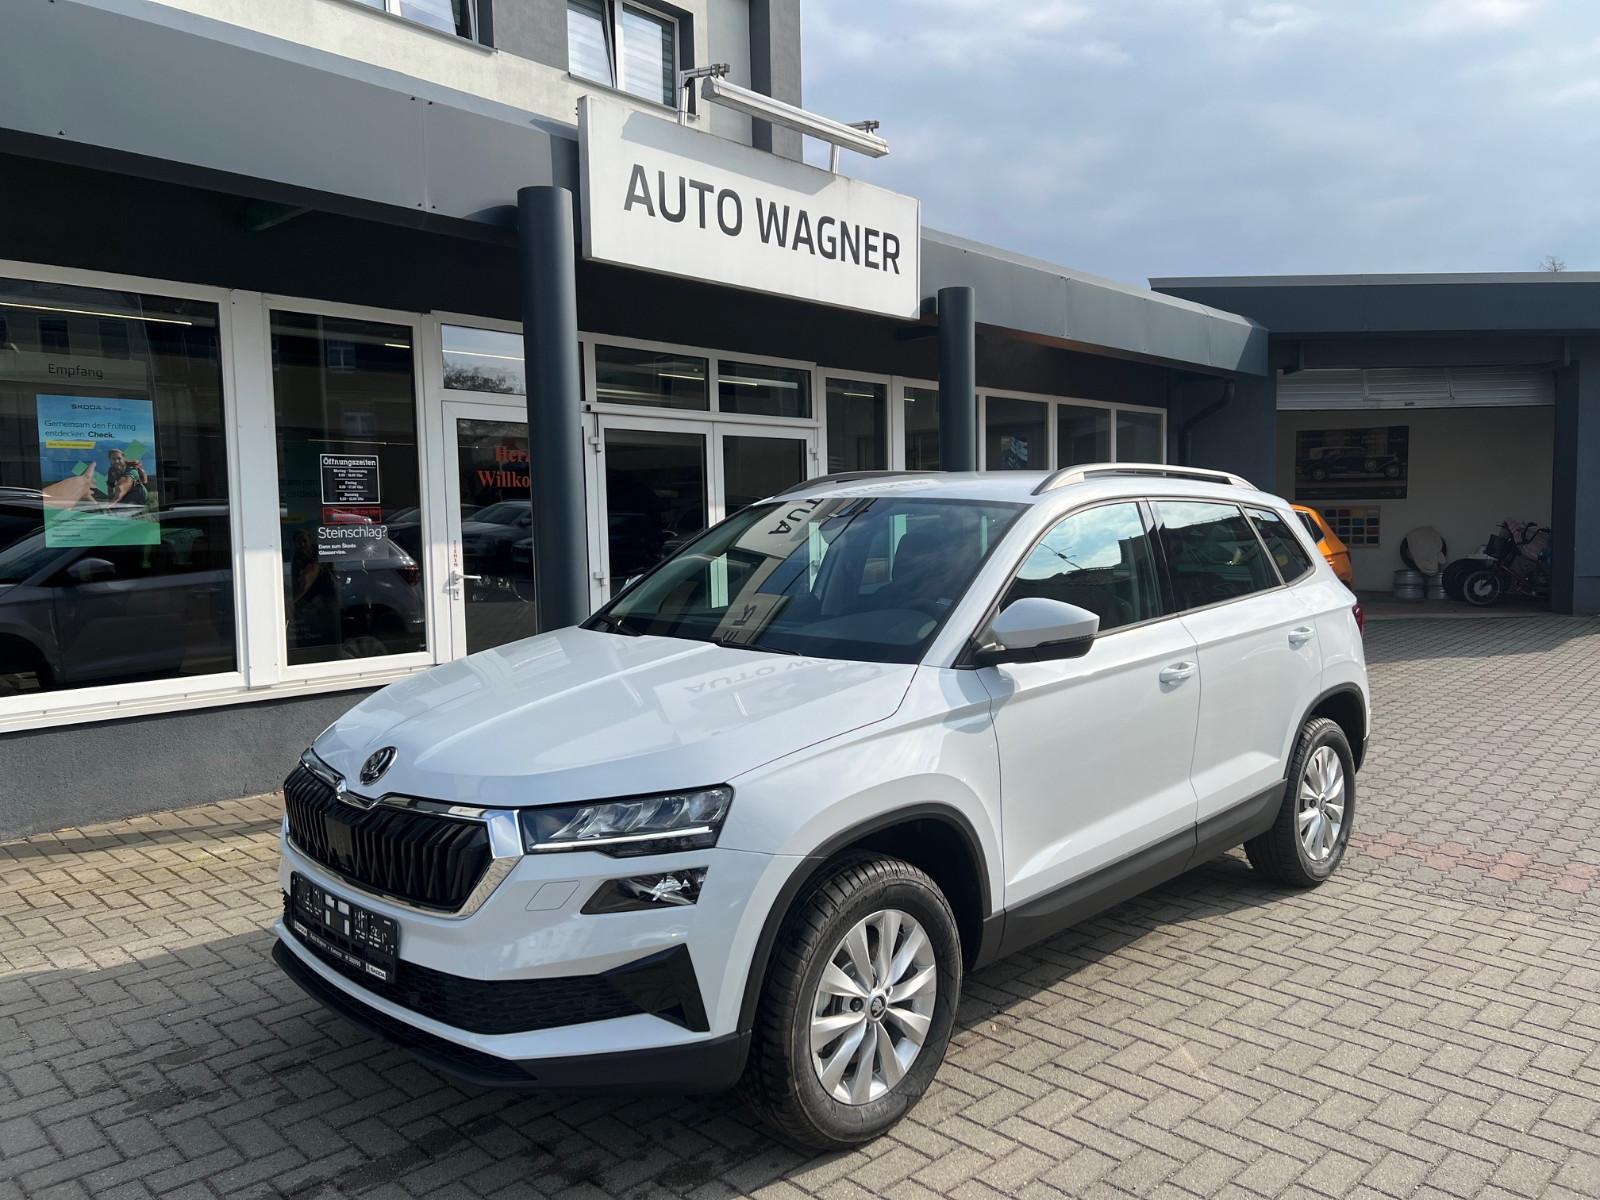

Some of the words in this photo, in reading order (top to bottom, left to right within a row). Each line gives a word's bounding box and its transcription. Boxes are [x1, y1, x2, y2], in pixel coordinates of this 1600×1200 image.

[623, 163, 743, 237] AUTO
[755, 197, 900, 275] WAGNER
[48, 363, 104, 380] Empfang
[92, 421, 106, 429] den
[323, 457, 376, 466] Öffnungszeiten
[318, 525, 388, 540] Steinschlag?
